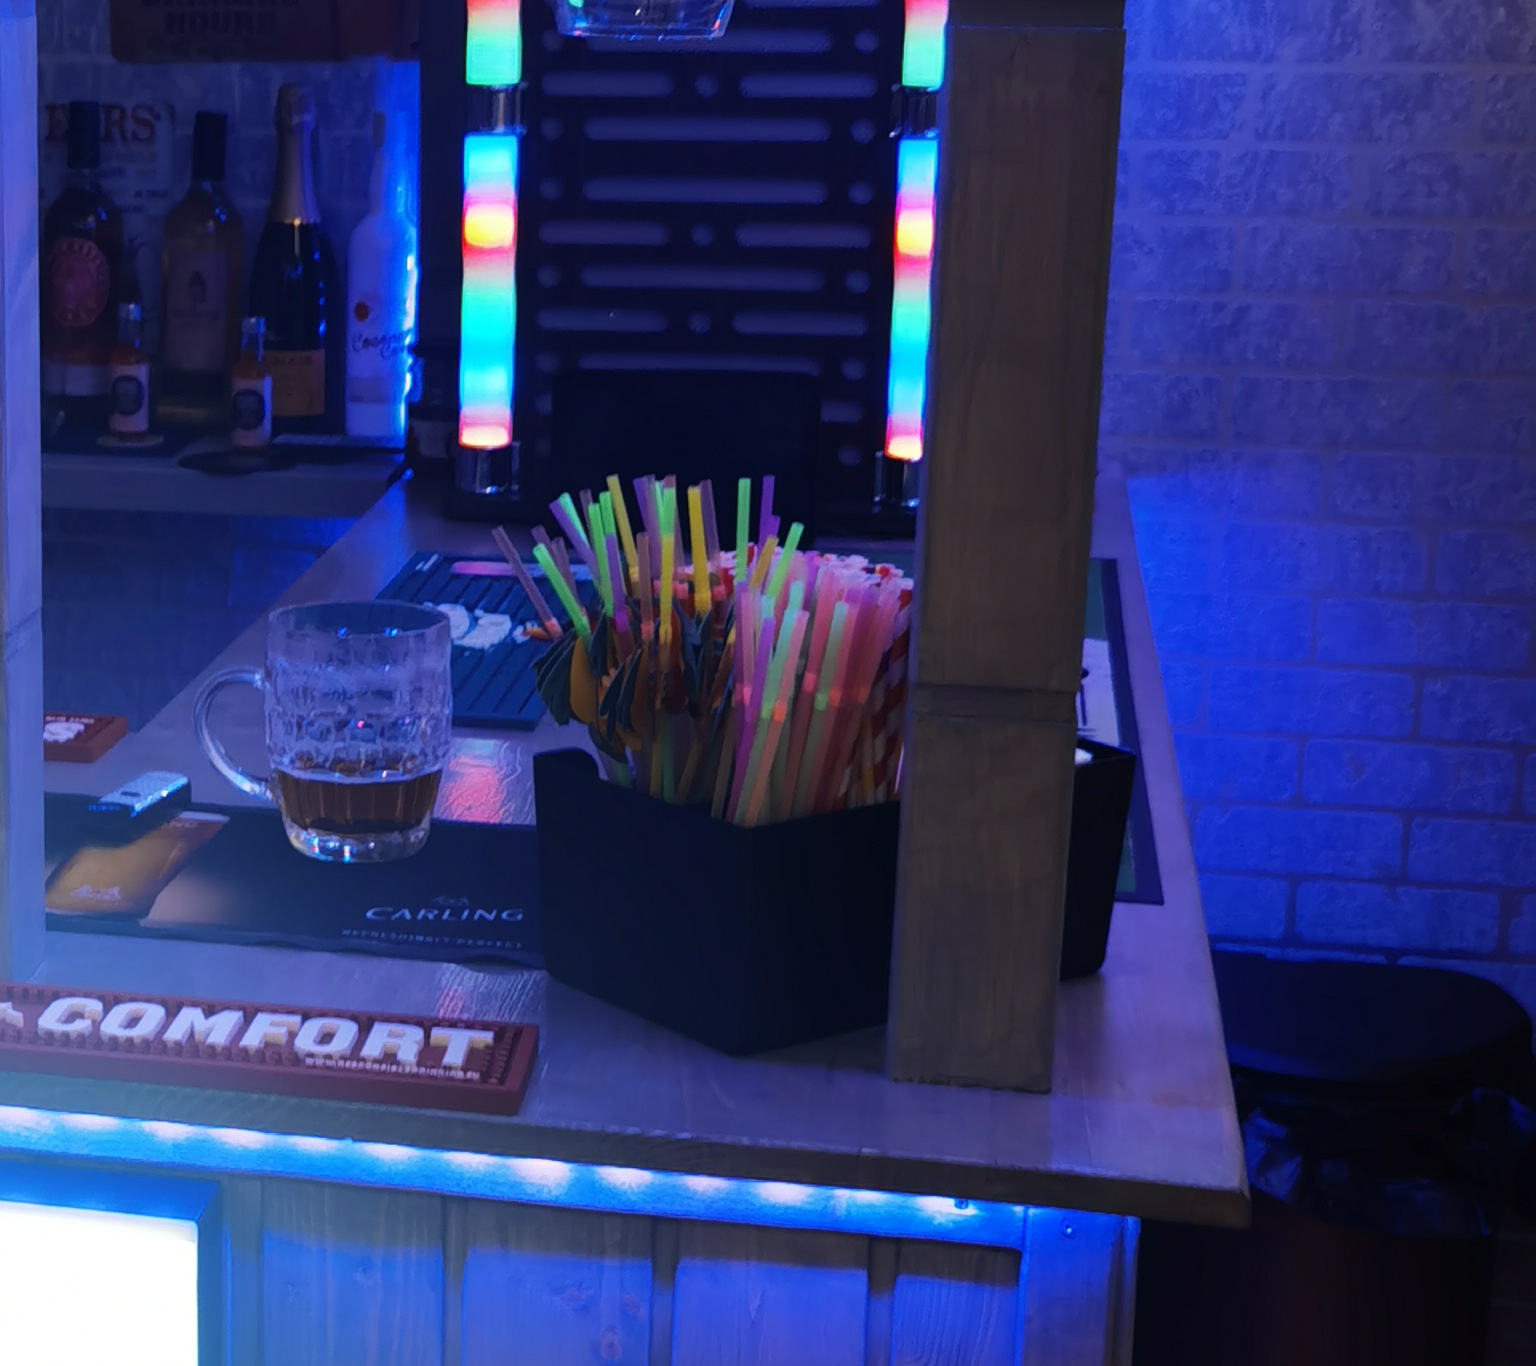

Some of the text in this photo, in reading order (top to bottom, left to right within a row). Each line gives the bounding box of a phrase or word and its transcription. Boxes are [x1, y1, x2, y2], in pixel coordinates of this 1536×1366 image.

[165, 12, 276, 34] HOURS
[365, 906, 524, 922] CARLING
[37, 997, 495, 1068] COMFORT
